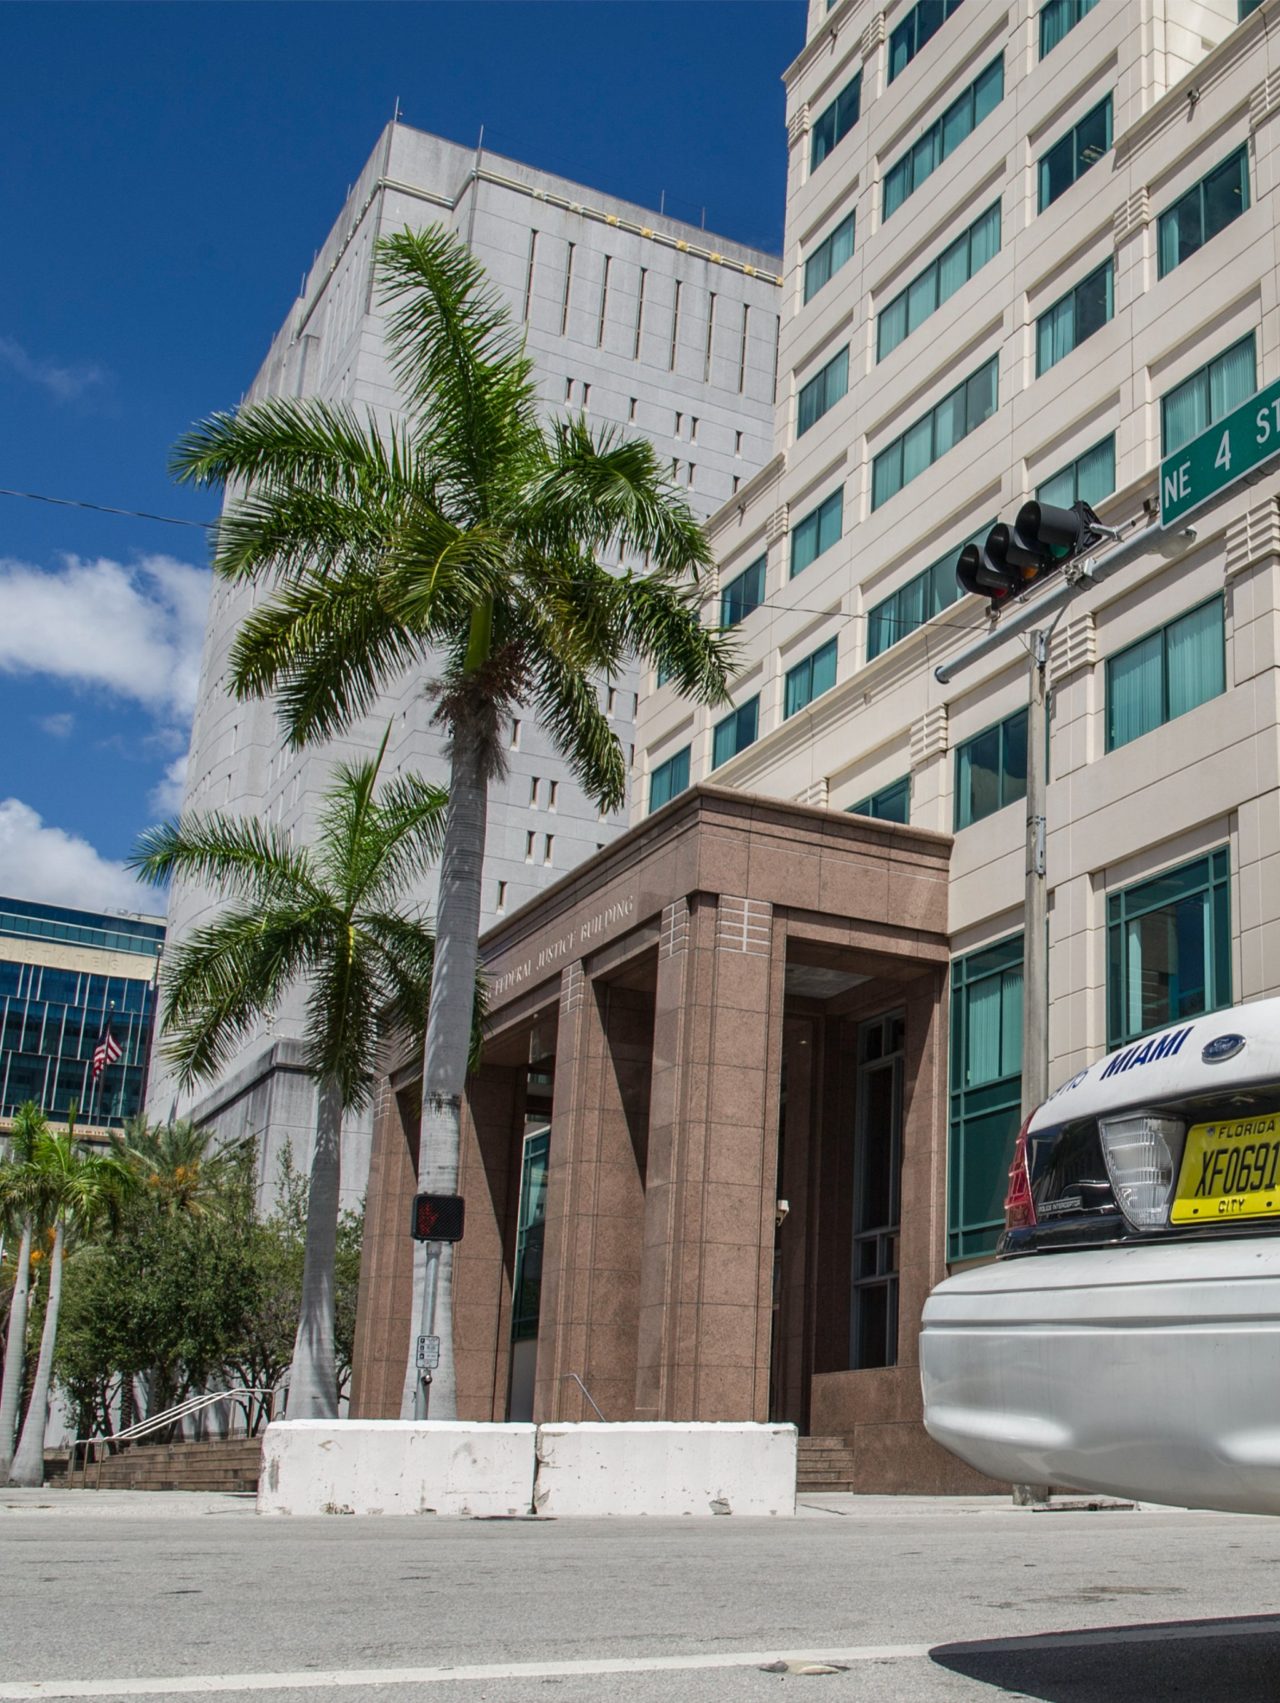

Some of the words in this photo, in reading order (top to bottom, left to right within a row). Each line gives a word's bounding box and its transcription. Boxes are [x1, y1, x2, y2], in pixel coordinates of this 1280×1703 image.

[1164, 460, 1192, 509] NE
[1214, 429, 1232, 471] 4
[536, 929, 577, 971] JUSTICE
[580, 895, 634, 943] BUILDING
[1099, 1025, 1196, 1082] MIAMI
[1218, 1119, 1276, 1139] FLORIDA
[1218, 1199, 1246, 1214] CITY
